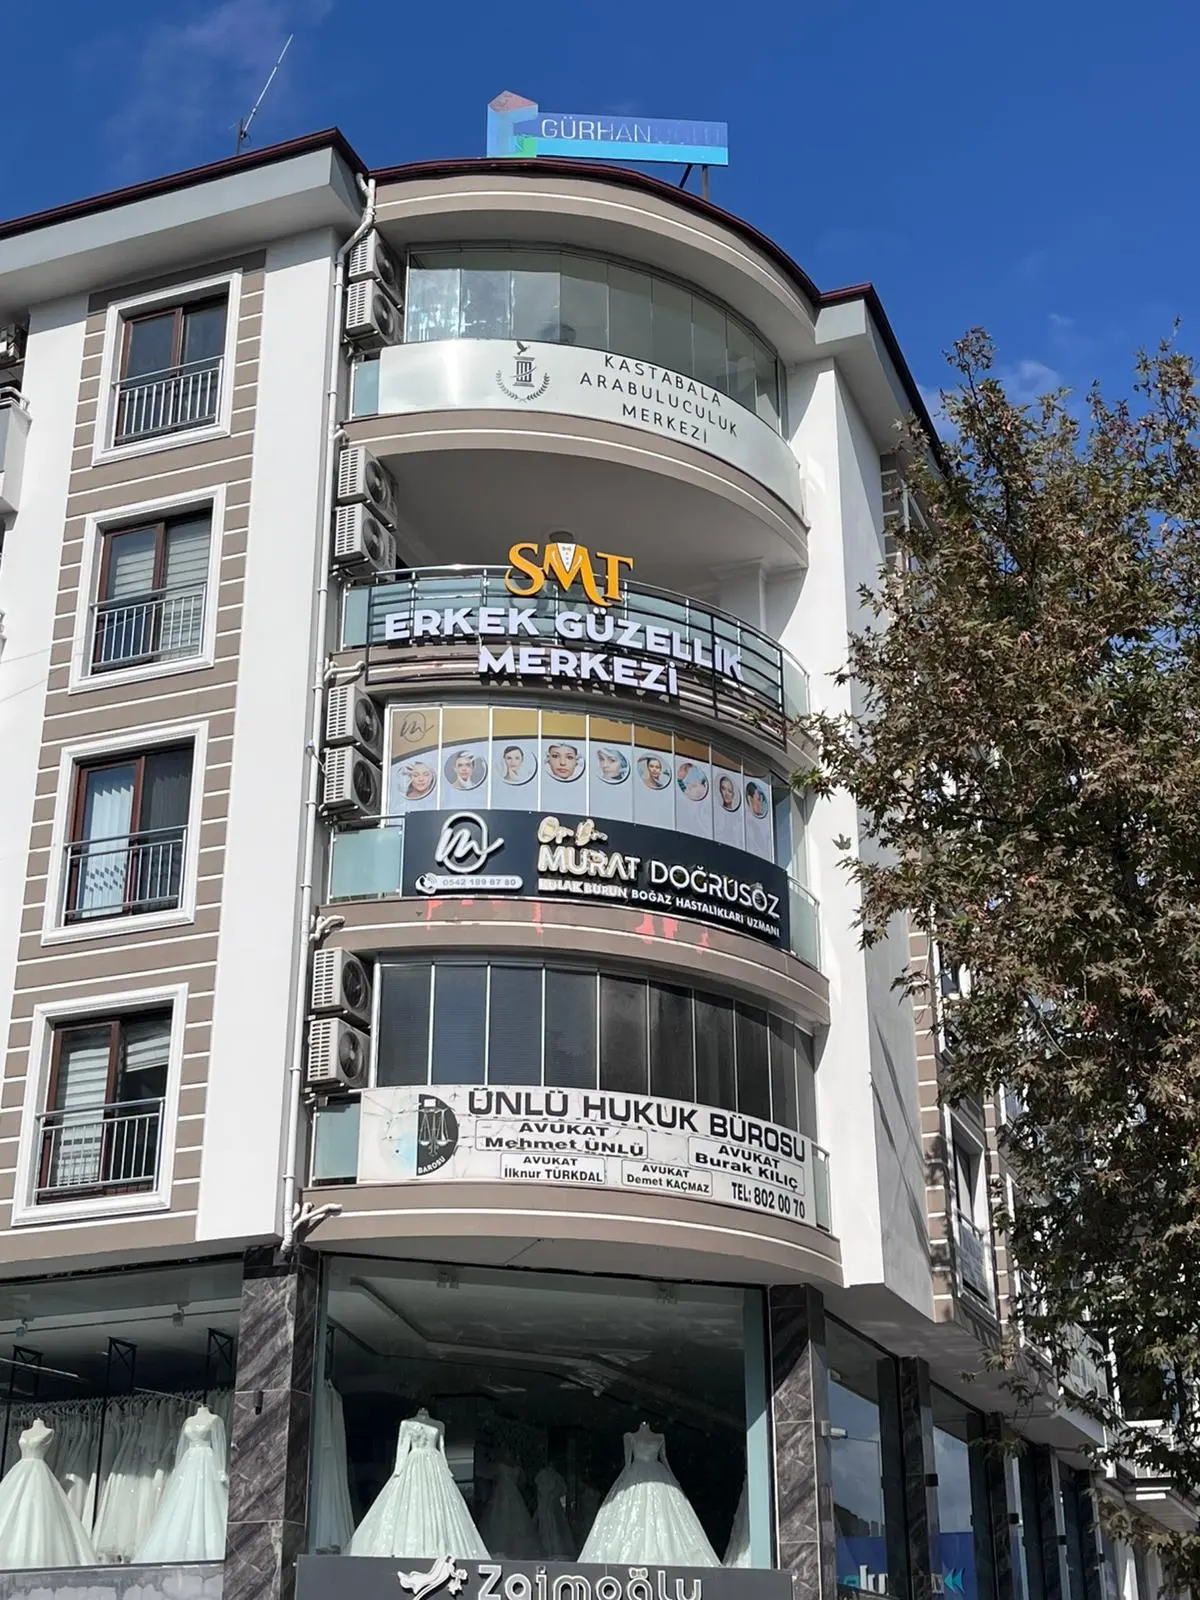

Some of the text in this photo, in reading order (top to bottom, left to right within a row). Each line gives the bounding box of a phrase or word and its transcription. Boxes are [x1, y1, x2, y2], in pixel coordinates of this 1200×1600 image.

[541, 116, 651, 142] GÜRHAN
[604, 354, 721, 407] KASTABALA
[580, 372, 737, 437] ARABULUCULUK
[504, 542, 634, 607] SMT
[385, 607, 745, 683] ERKEK GÜZELLİK
[478, 646, 679, 695] MERKEZİ
[538, 844, 641, 880] MURAT
[583, 882, 628, 898] BURUN
[631, 888, 672, 905] BOĞAZ
[676, 896, 744, 924] HASTALIKLARI
[746, 917, 780, 938] UZMANI
[469, 1088, 805, 1162] ÜNLÜ HUKUK BÜROSU
[519, 1122, 610, 1137] AVUKAT
[485, 1137, 644, 1157] Mehmet ÜNLÜ
[523, 1156, 578, 1166] AVUKAT
[719, 1145, 780, 1169] AVUKAT
[504, 1165, 603, 1182] İlknur TÜRKDAL
[627, 1174, 710, 1195] Demet KAÇMAZ
[642, 1164, 690, 1179] AVUKAT
[695, 1152, 799, 1193] Burak KILIÇ
[731, 1182, 806, 1219] TEL: 802 00 70
